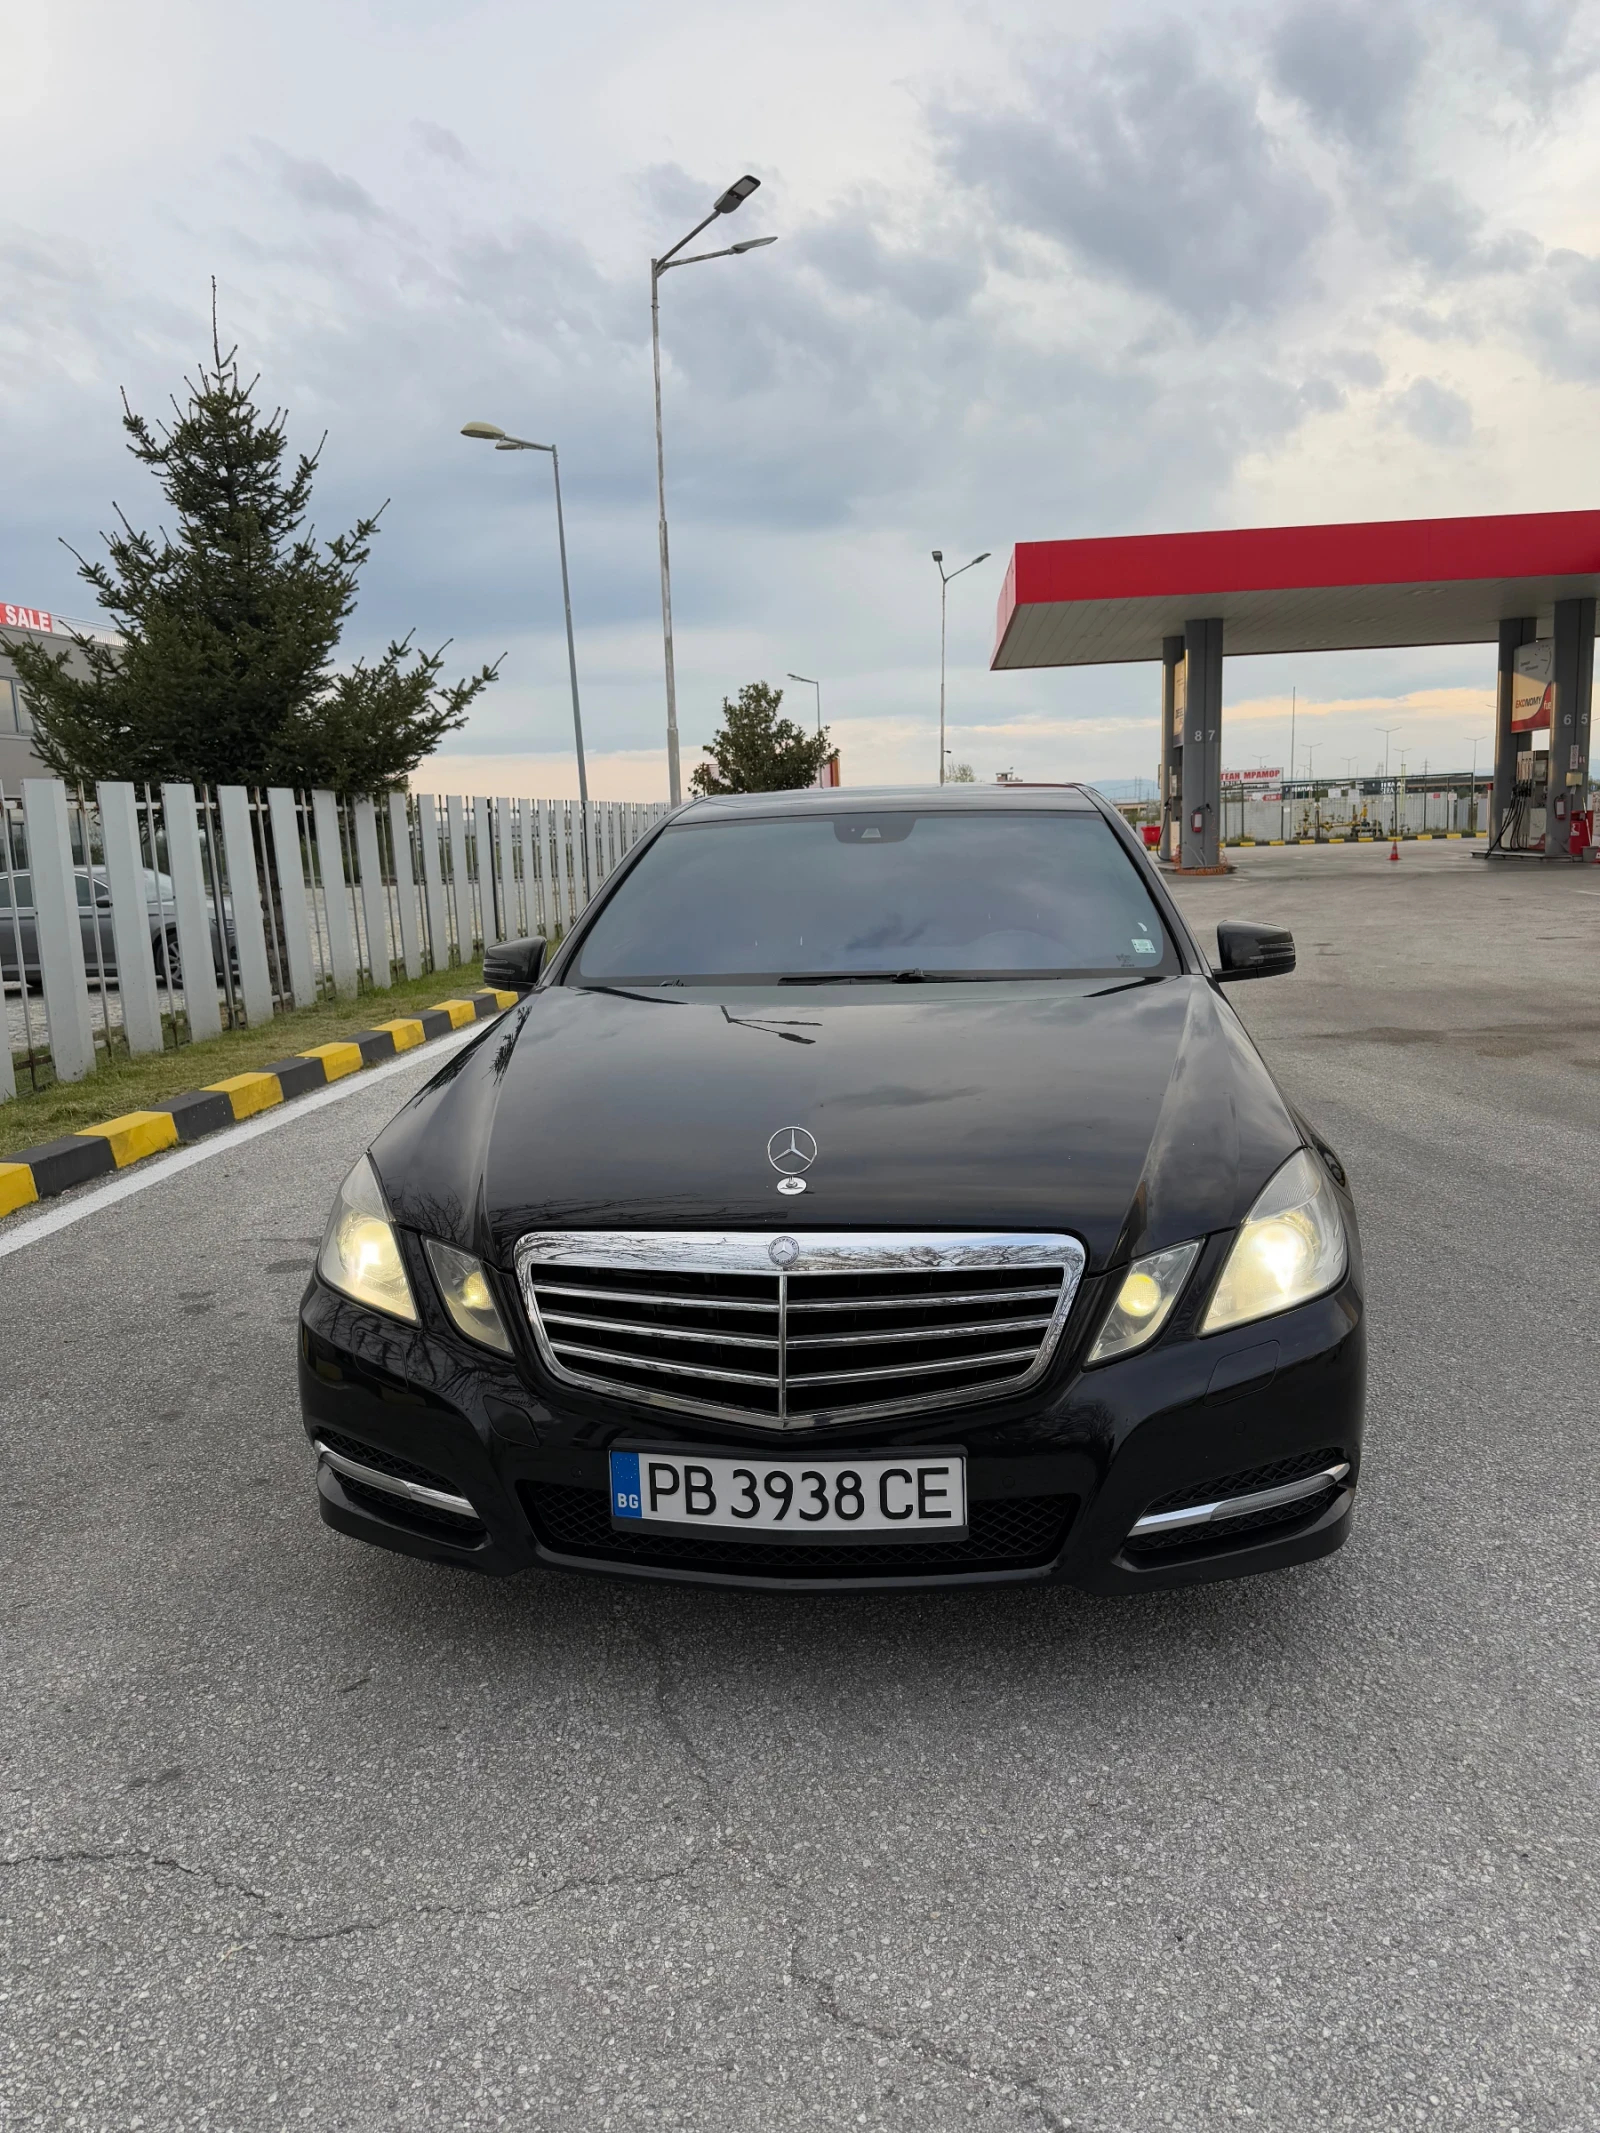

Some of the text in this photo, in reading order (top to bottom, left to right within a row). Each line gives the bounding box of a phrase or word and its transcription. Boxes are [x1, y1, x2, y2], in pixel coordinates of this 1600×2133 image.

[5, 604, 51, 632] SALE
[1563, 713, 1588, 725] 6 5
[1194, 729, 1216, 741] 8 7
[1243, 769, 1280, 780] МРАМОР
[648, 1462, 952, 1521] PB 3938 CE
[617, 1493, 639, 1509] BG
